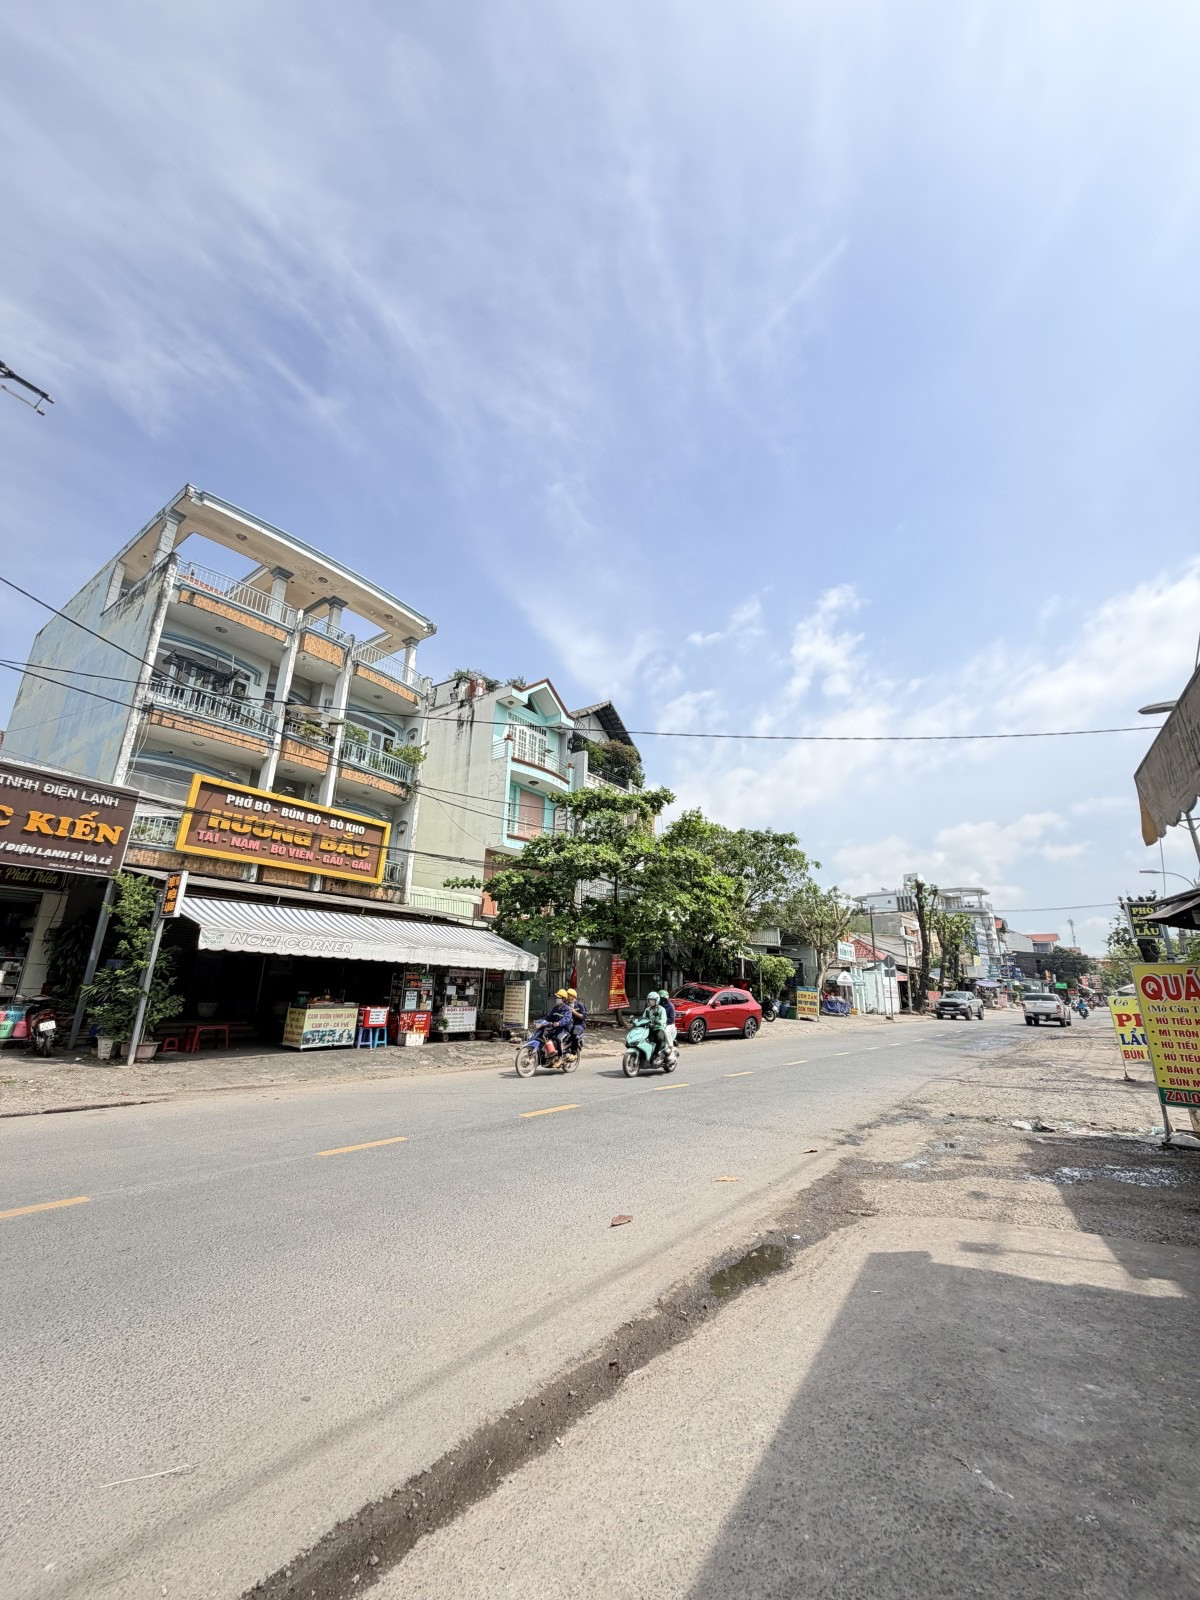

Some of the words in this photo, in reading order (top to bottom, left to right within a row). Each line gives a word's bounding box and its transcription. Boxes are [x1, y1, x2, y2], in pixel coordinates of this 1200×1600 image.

[43, 783, 78, 799] ĐIỆN
[81, 790, 119, 807] LẠNH
[225, 793, 255, 810] PHỞ
[254, 799, 271, 814] BÒ
[280, 806, 306, 822] BÚN
[306, 812, 322, 826] BÒ
[329, 817, 344, 831] BÒ
[345, 823, 366, 836] KHO
[24, 811, 124, 845] KIẾN
[207, 808, 312, 847] HƯƠNG
[319, 832, 371, 858] BẮC
[36, 847, 70, 858] LẠNH
[83, 853, 98, 863] VÀ
[98, 855, 113, 865] LẺ
[230, 836, 260, 852] NẠM
[270, 843, 287, 856] BÒ
[288, 847, 315, 861] VIÊN
[5, 867, 32, 882] Phát
[230, 931, 282, 948] NORI
[284, 937, 353, 953] CORNER
[1171, 1015, 1192, 1026] TIẾU
[1172, 1029, 1199, 1040] TRỘN
[1123, 1047, 1145, 1059] BÚN
[1176, 1040, 1198, 1051] TIẾU
[1166, 1064, 1194, 1075] BÁNH
[1169, 1076, 1190, 1087] BÚN
